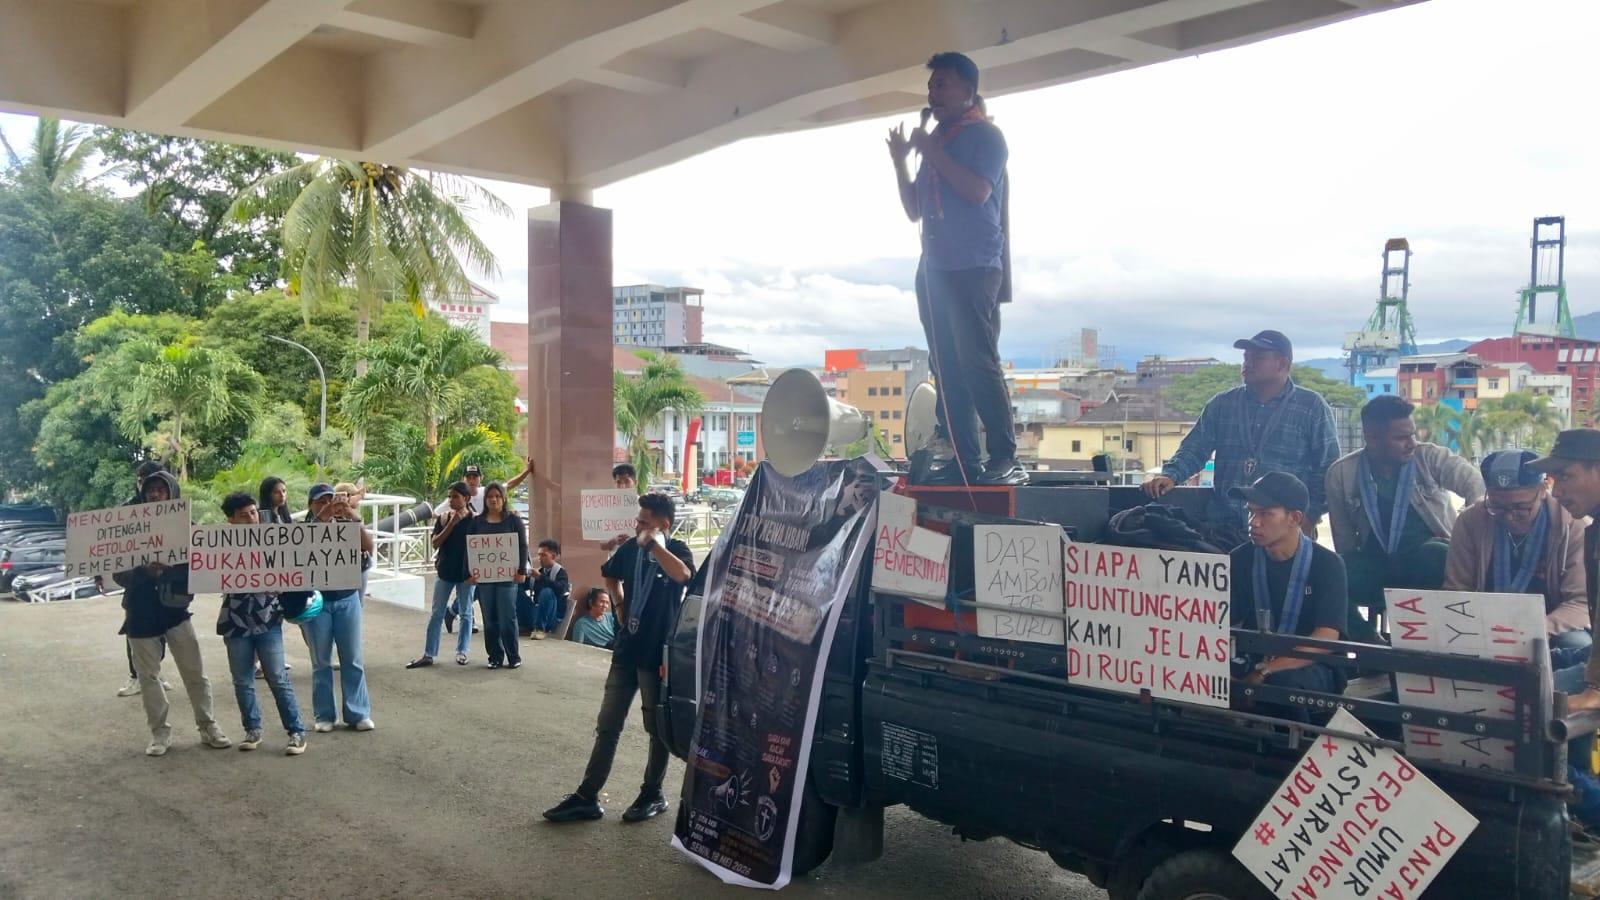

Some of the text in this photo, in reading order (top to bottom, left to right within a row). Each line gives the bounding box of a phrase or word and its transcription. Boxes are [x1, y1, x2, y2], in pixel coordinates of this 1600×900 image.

[68, 501, 186, 528] MENOLAK DIAM
[89, 533, 164, 558] KETOLOL-AN
[97, 521, 151, 541] DITENGAH
[469, 536, 513, 549] GMKI
[65, 546, 188, 577] PEMERINTAH
[478, 551, 511, 564] FOR
[985, 531, 1050, 567] DARI
[472, 566, 518, 580] BURU
[988, 568, 1062, 596] AMBON
[1066, 545, 1228, 592] SIAPA YANG
[1066, 581, 1229, 630] DIUNTUNGKAN?
[994, 614, 1055, 638] BURU
[1067, 616, 1228, 663] KAMI JELAS
[1067, 648, 1228, 701] DIRUGIKAN!!!
[1272, 756, 1323, 827] ADAT
[1343, 826, 1405, 897] UMUR
